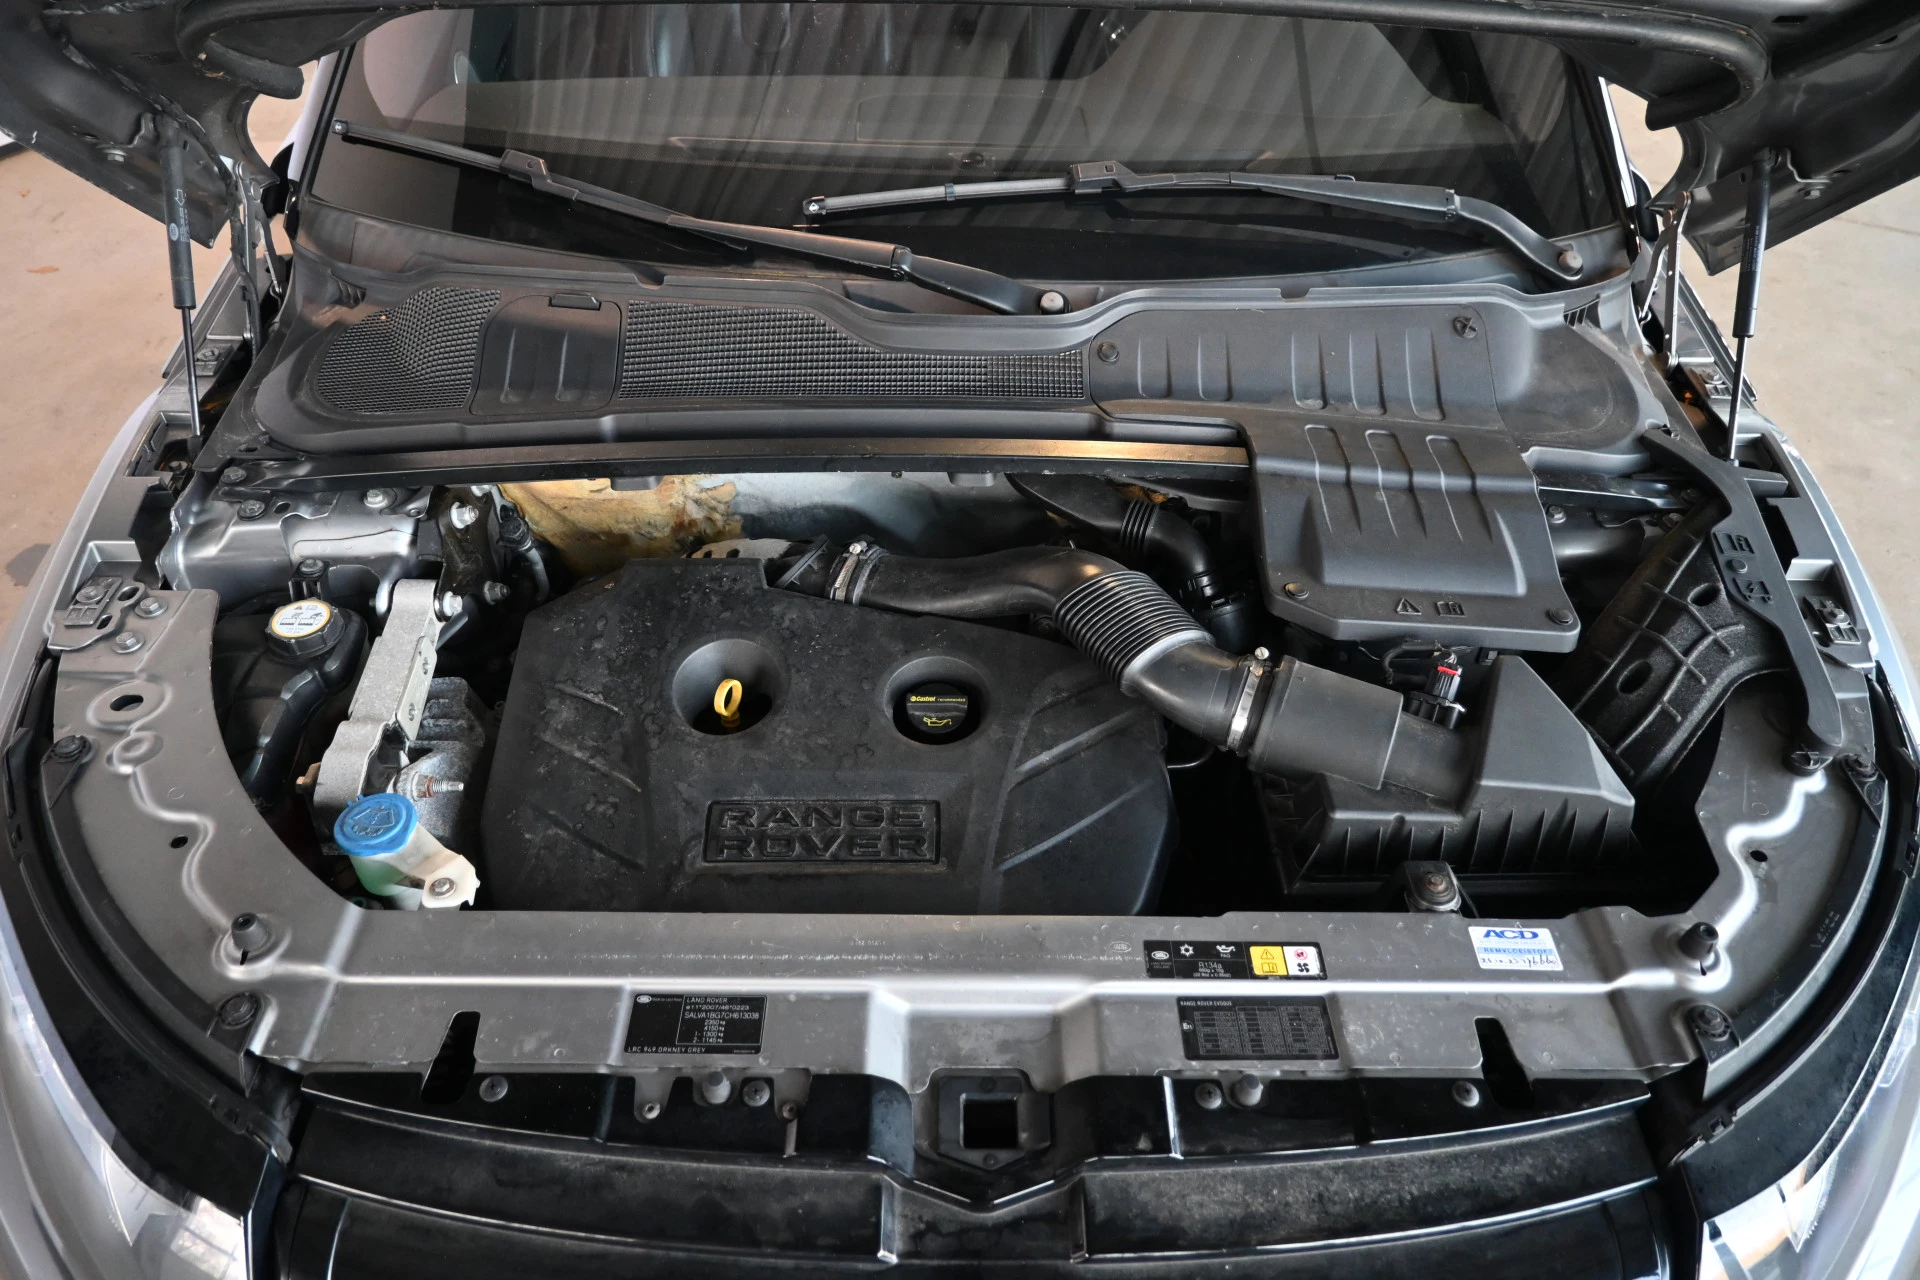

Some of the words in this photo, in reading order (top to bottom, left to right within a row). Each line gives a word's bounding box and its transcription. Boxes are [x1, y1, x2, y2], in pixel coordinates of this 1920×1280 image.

[720, 806, 925, 829] RANGE
[716, 833, 929, 859] ROVER
[1483, 929, 1539, 939] ACD
[1199, 961, 1222, 969] R134a
